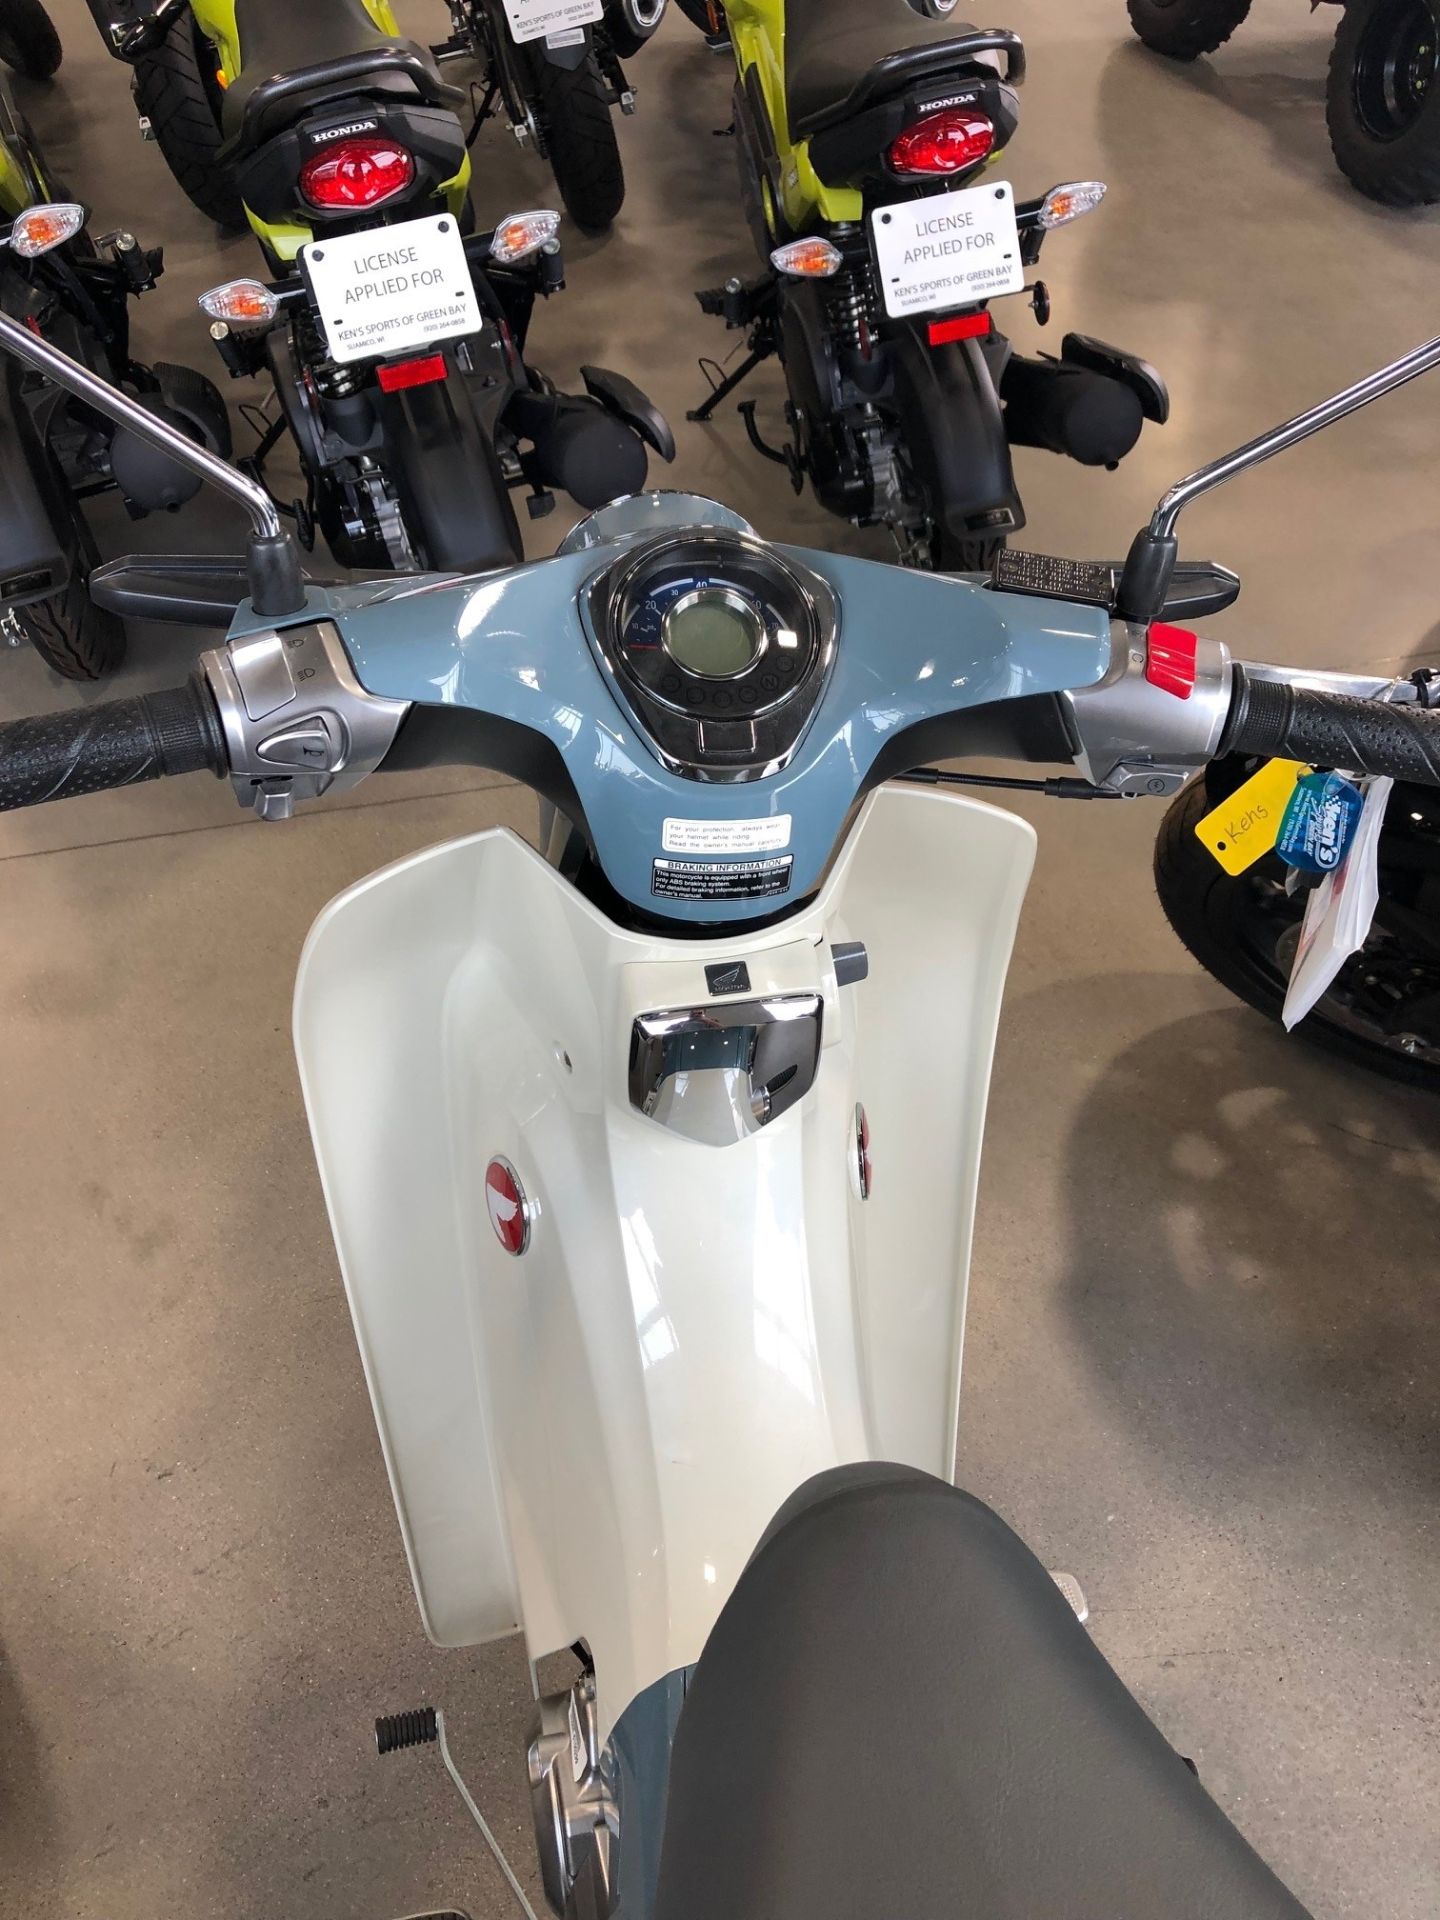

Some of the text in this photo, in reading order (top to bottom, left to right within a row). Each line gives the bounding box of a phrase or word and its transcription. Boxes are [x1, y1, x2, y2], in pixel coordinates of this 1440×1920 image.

[919, 94, 976, 112] HONDA
[312, 121, 376, 143] HONDA
[916, 211, 974, 237] LICENSE
[904, 232, 995, 265] APPLIED FOR
[354, 246, 418, 275] LICENSE
[345, 268, 445, 304] APPLIED FOR
[894, 264, 1013, 298] KEN'S SPORTS OF GREEN BAY
[338, 303, 467, 342] KEN'S SPORTS OF GREEN BAY
[696, 581, 708, 589] 40
[645, 600, 657, 610] 20
[632, 622, 639, 630] 10
[667, 859, 782, 872] BRAKING INFORMATION
[670, 872, 703, 880] motorcycle
[771, 867, 788, 875] wheel
[666, 884, 690, 892] detailed
[684, 880, 707, 888] braking
[655, 889, 678, 897] owner's
